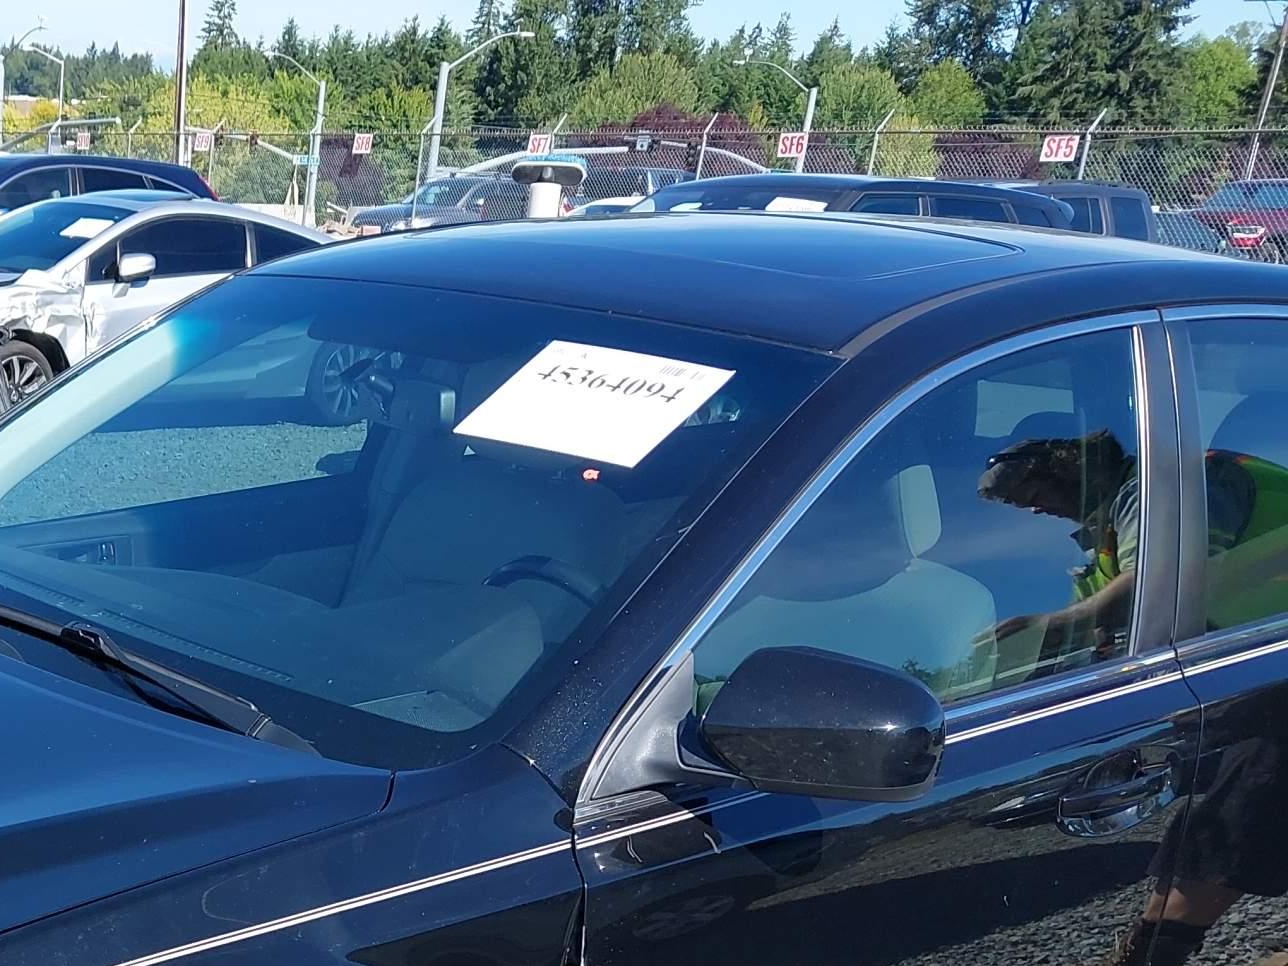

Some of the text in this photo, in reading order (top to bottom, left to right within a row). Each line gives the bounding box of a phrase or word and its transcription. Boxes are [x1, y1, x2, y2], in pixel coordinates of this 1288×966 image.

[195, 134, 210, 149] SF9
[354, 135, 372, 151] SF8
[530, 137, 549, 153] SF7
[780, 136, 804, 154] SF6
[1044, 137, 1075, 158] SF5
[538, 365, 685, 403] 45364094
